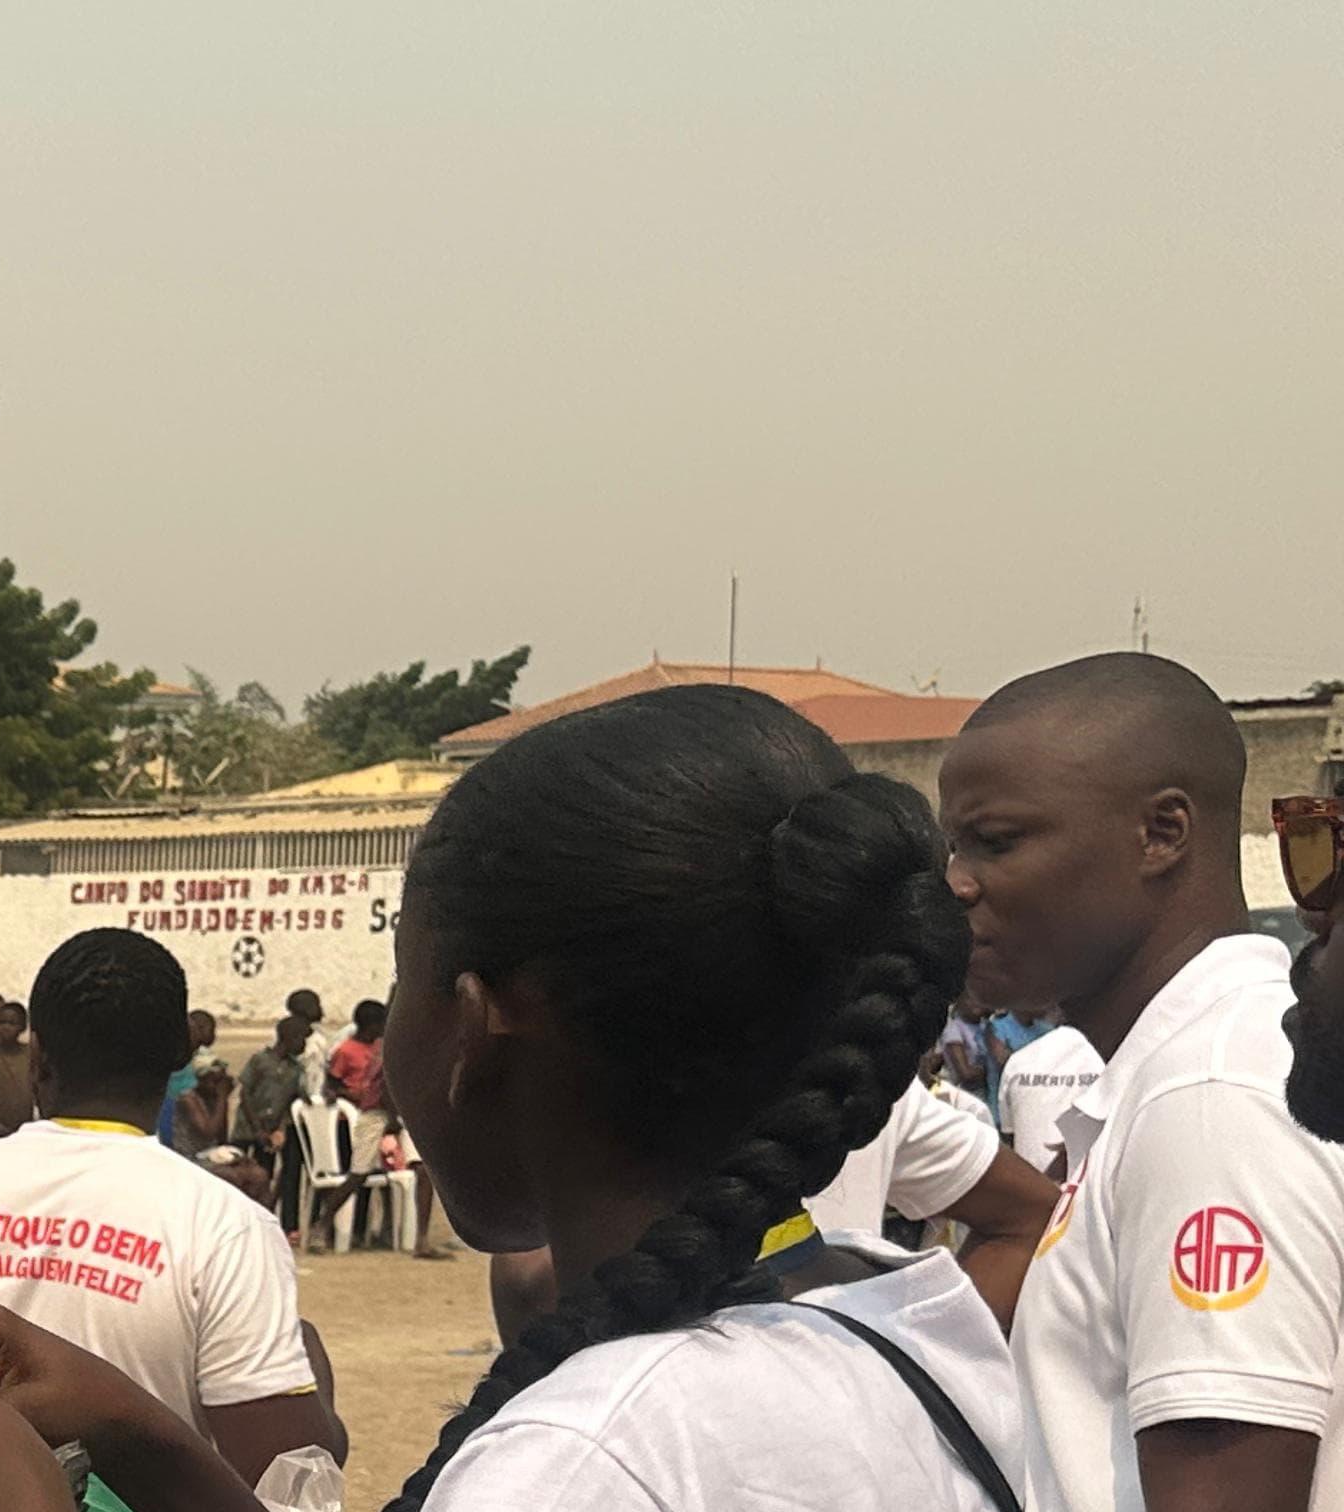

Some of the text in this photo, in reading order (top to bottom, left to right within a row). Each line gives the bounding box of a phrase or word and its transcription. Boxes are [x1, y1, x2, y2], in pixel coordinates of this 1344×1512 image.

[139, 879, 163, 903] DO
[68, 1218, 90, 1250] O
[93, 1224, 166, 1278] BEM,
[73, 1262, 144, 1305] FELIZ!
